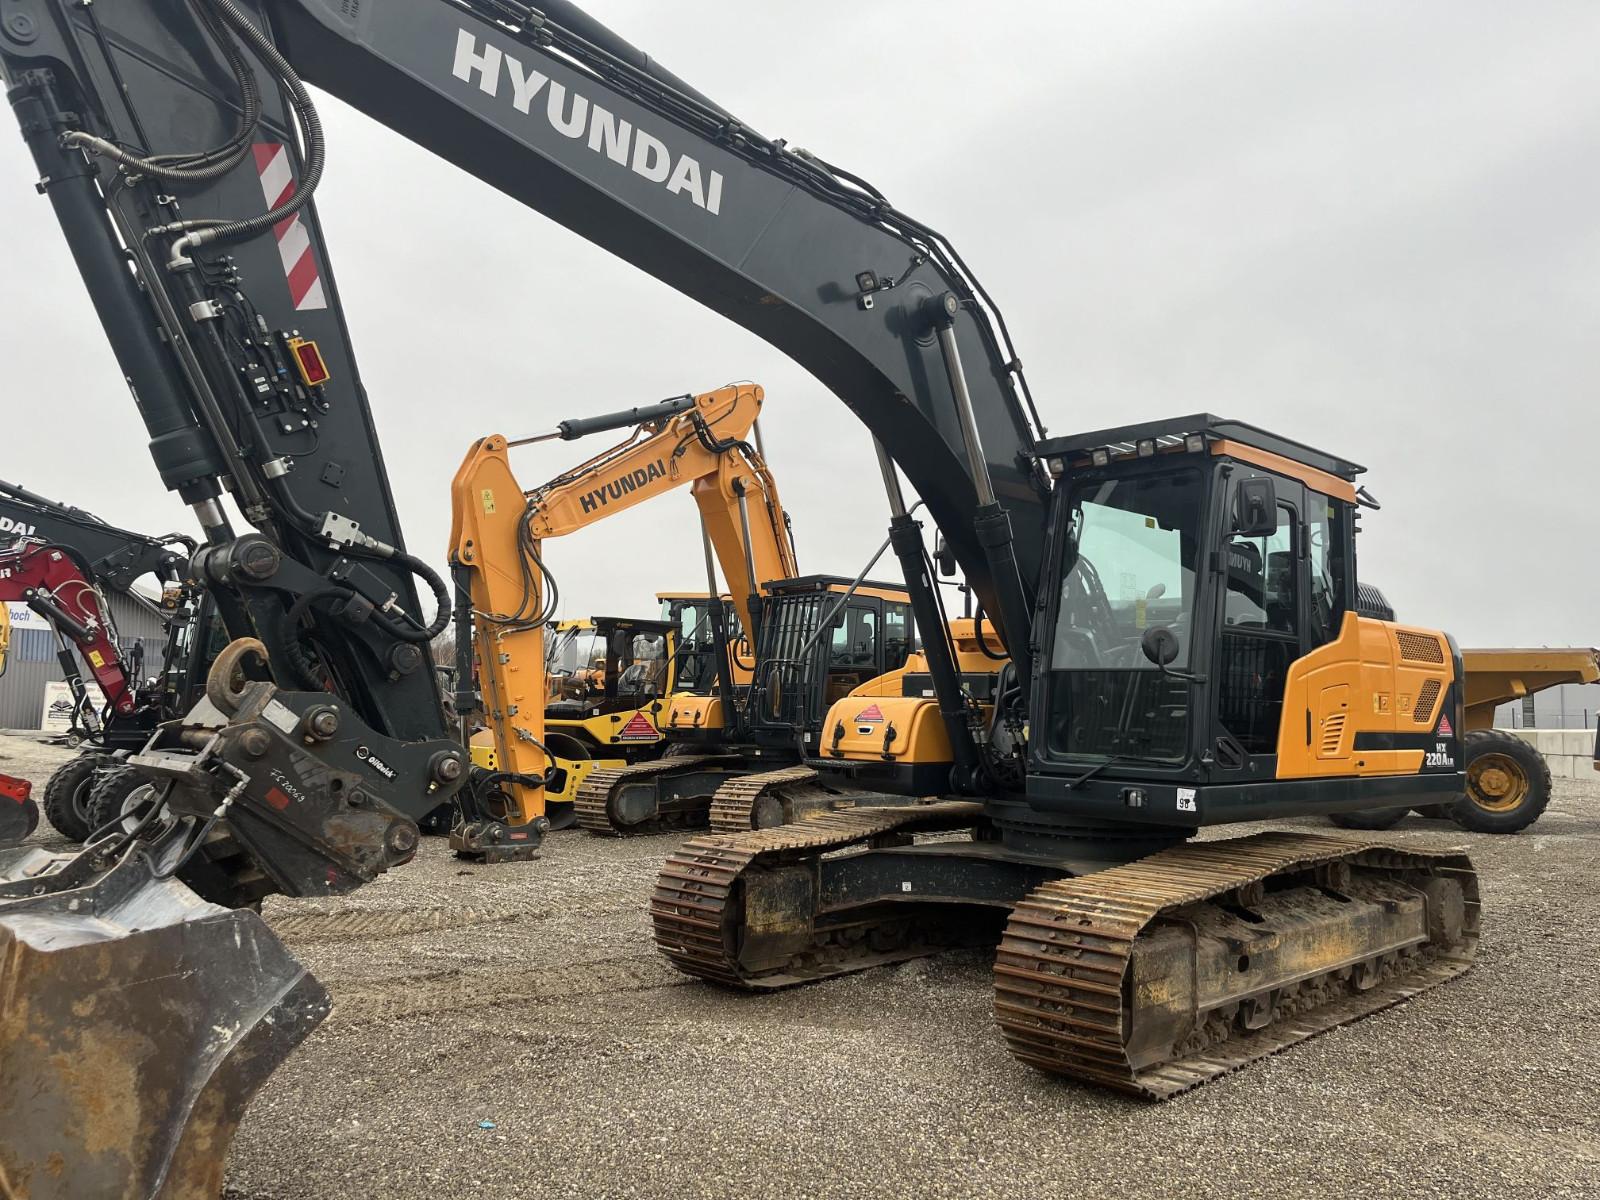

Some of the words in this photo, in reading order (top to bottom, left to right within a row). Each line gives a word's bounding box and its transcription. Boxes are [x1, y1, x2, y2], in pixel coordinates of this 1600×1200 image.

[452, 28, 724, 216] HYUNDAI
[579, 458, 667, 514] HYUNDAI
[1436, 742, 1447, 752] HX
[368, 756, 397, 778] OilQuick
